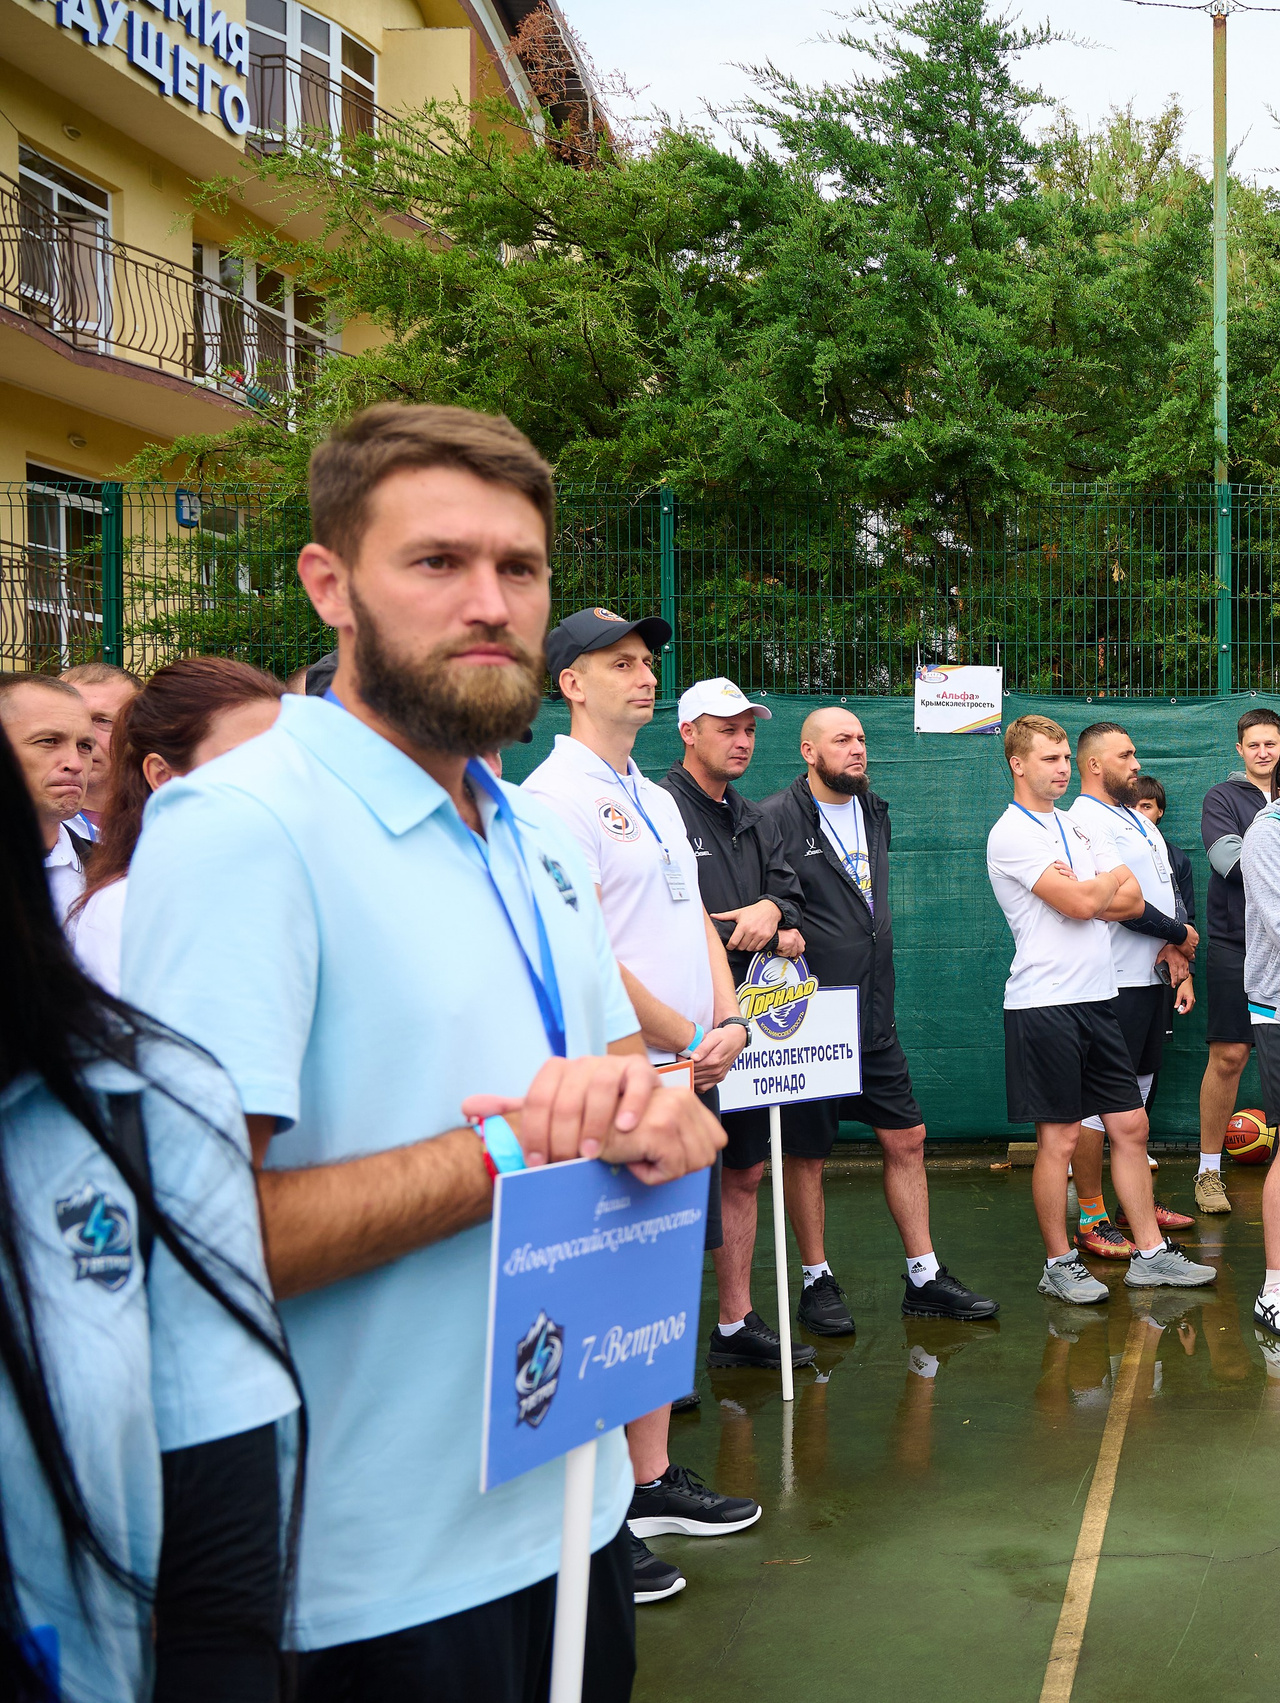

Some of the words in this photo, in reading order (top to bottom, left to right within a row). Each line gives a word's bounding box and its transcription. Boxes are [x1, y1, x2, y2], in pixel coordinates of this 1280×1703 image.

[139, 0, 249, 77] МИЯ
[56, 0, 251, 136] ДУЩЕГО
[921, 699, 995, 709] Крымскэлектросеть
[936, 691, 979, 701] «Альфа»
[729, 1043, 853, 1072] АНИНСКЭЛЕКТРОСЕТЬ
[753, 1072, 806, 1096] ТОРНАДО
[578, 1310, 687, 1381] 7-Ветров
